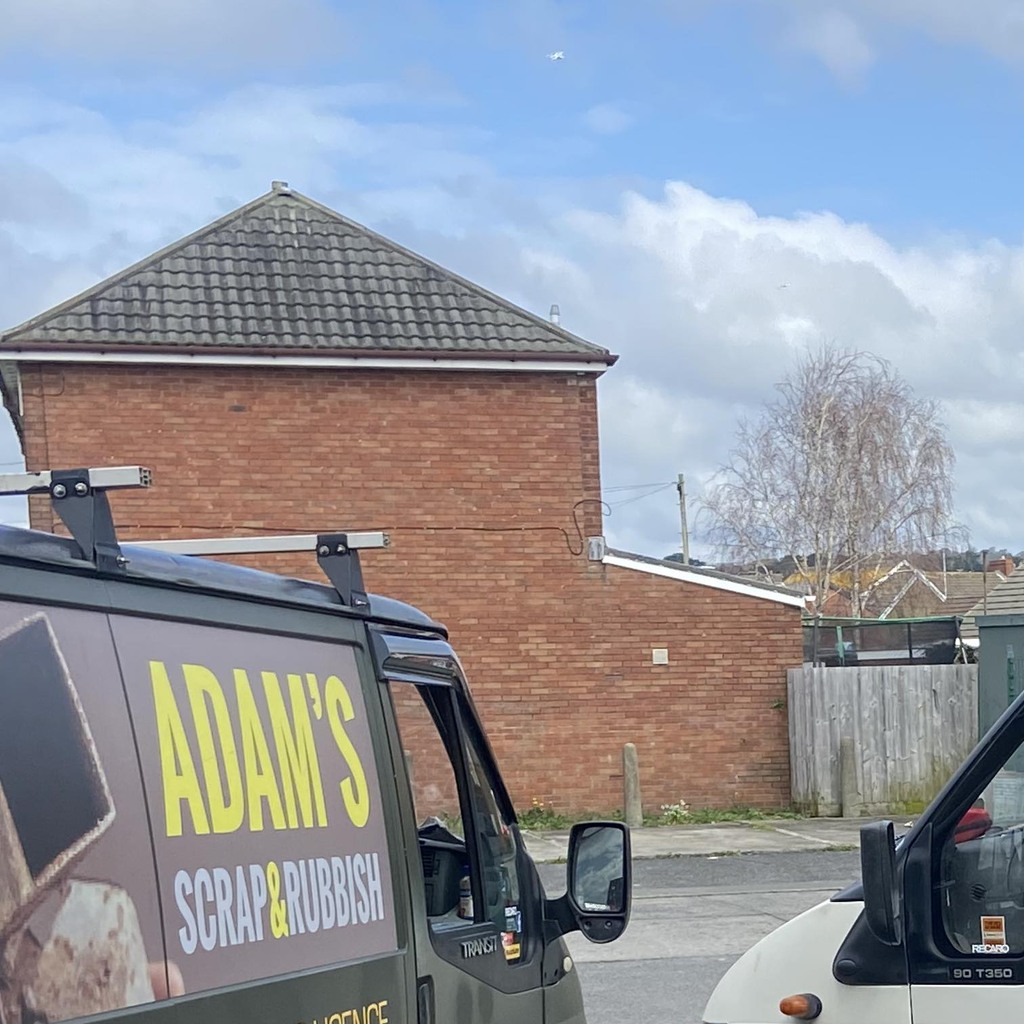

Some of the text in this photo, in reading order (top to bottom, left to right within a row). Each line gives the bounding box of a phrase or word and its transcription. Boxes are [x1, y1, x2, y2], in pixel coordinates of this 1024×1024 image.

[149, 660, 370, 837] ADAM'S
[461, 935, 498, 959] TRANSIT
[971, 944, 1010, 954] RECARO
[953, 968, 1013, 979] 90 T350
